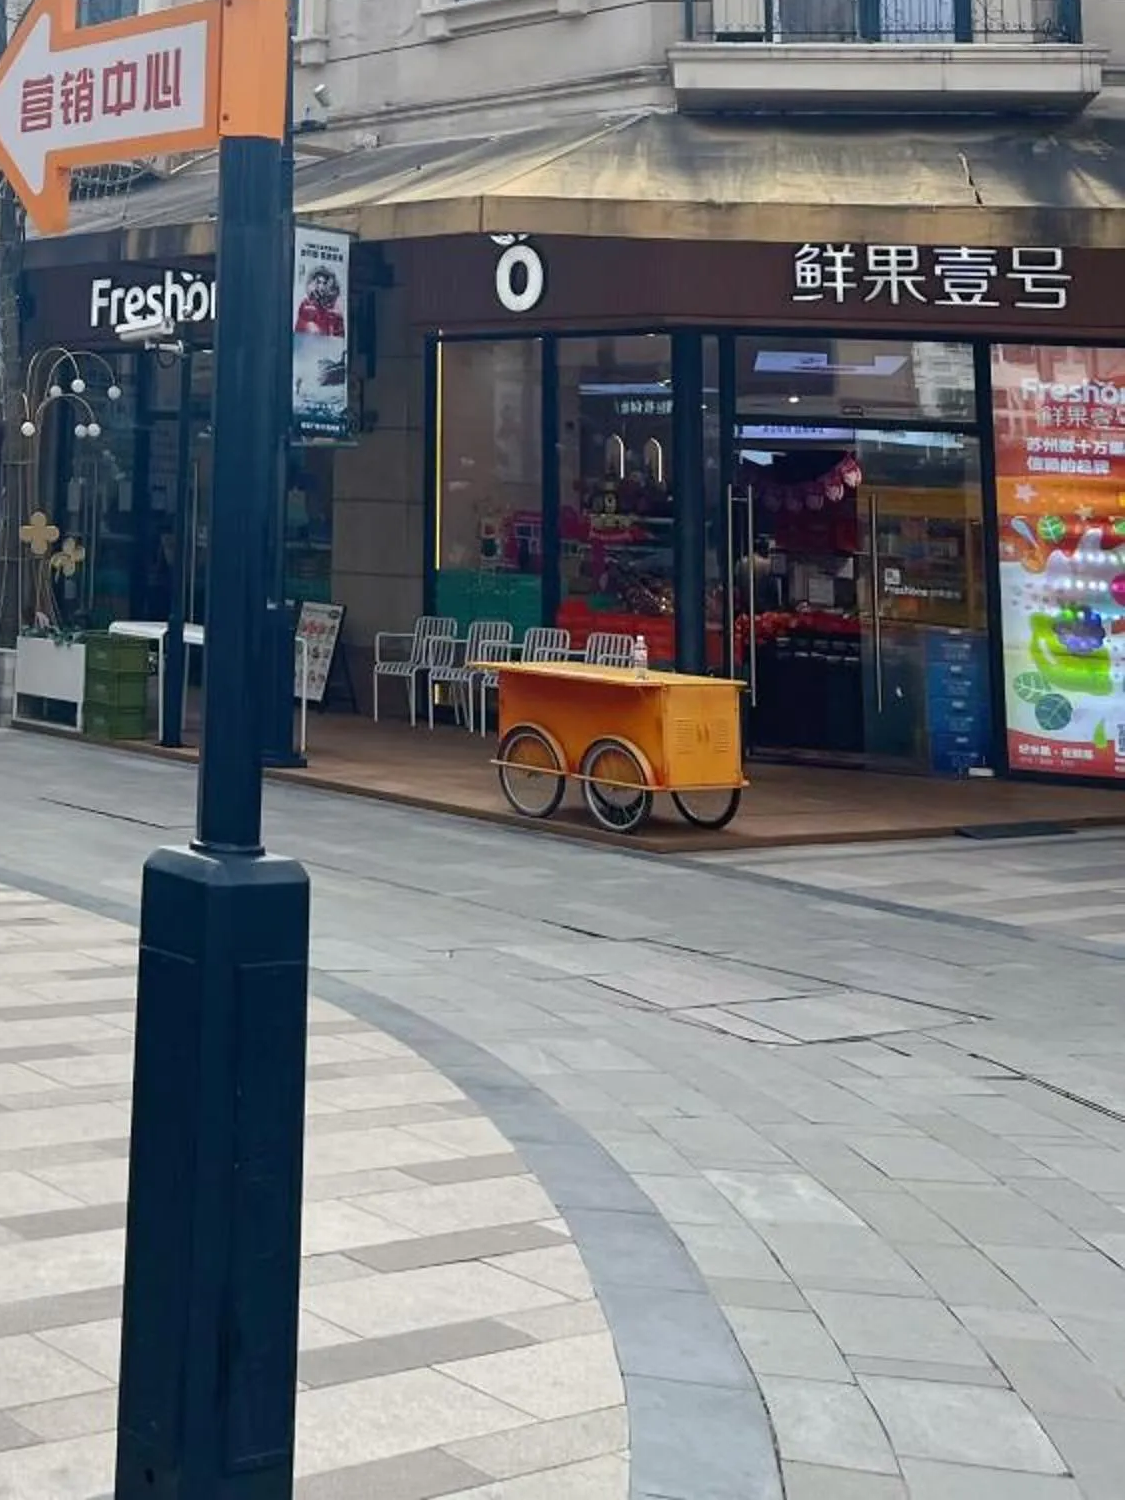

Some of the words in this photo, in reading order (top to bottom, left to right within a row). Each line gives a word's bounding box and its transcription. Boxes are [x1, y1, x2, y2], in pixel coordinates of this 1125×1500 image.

[20, 47, 183, 134] 营销中心
[792, 242, 1073, 310] 鲜果壹号
